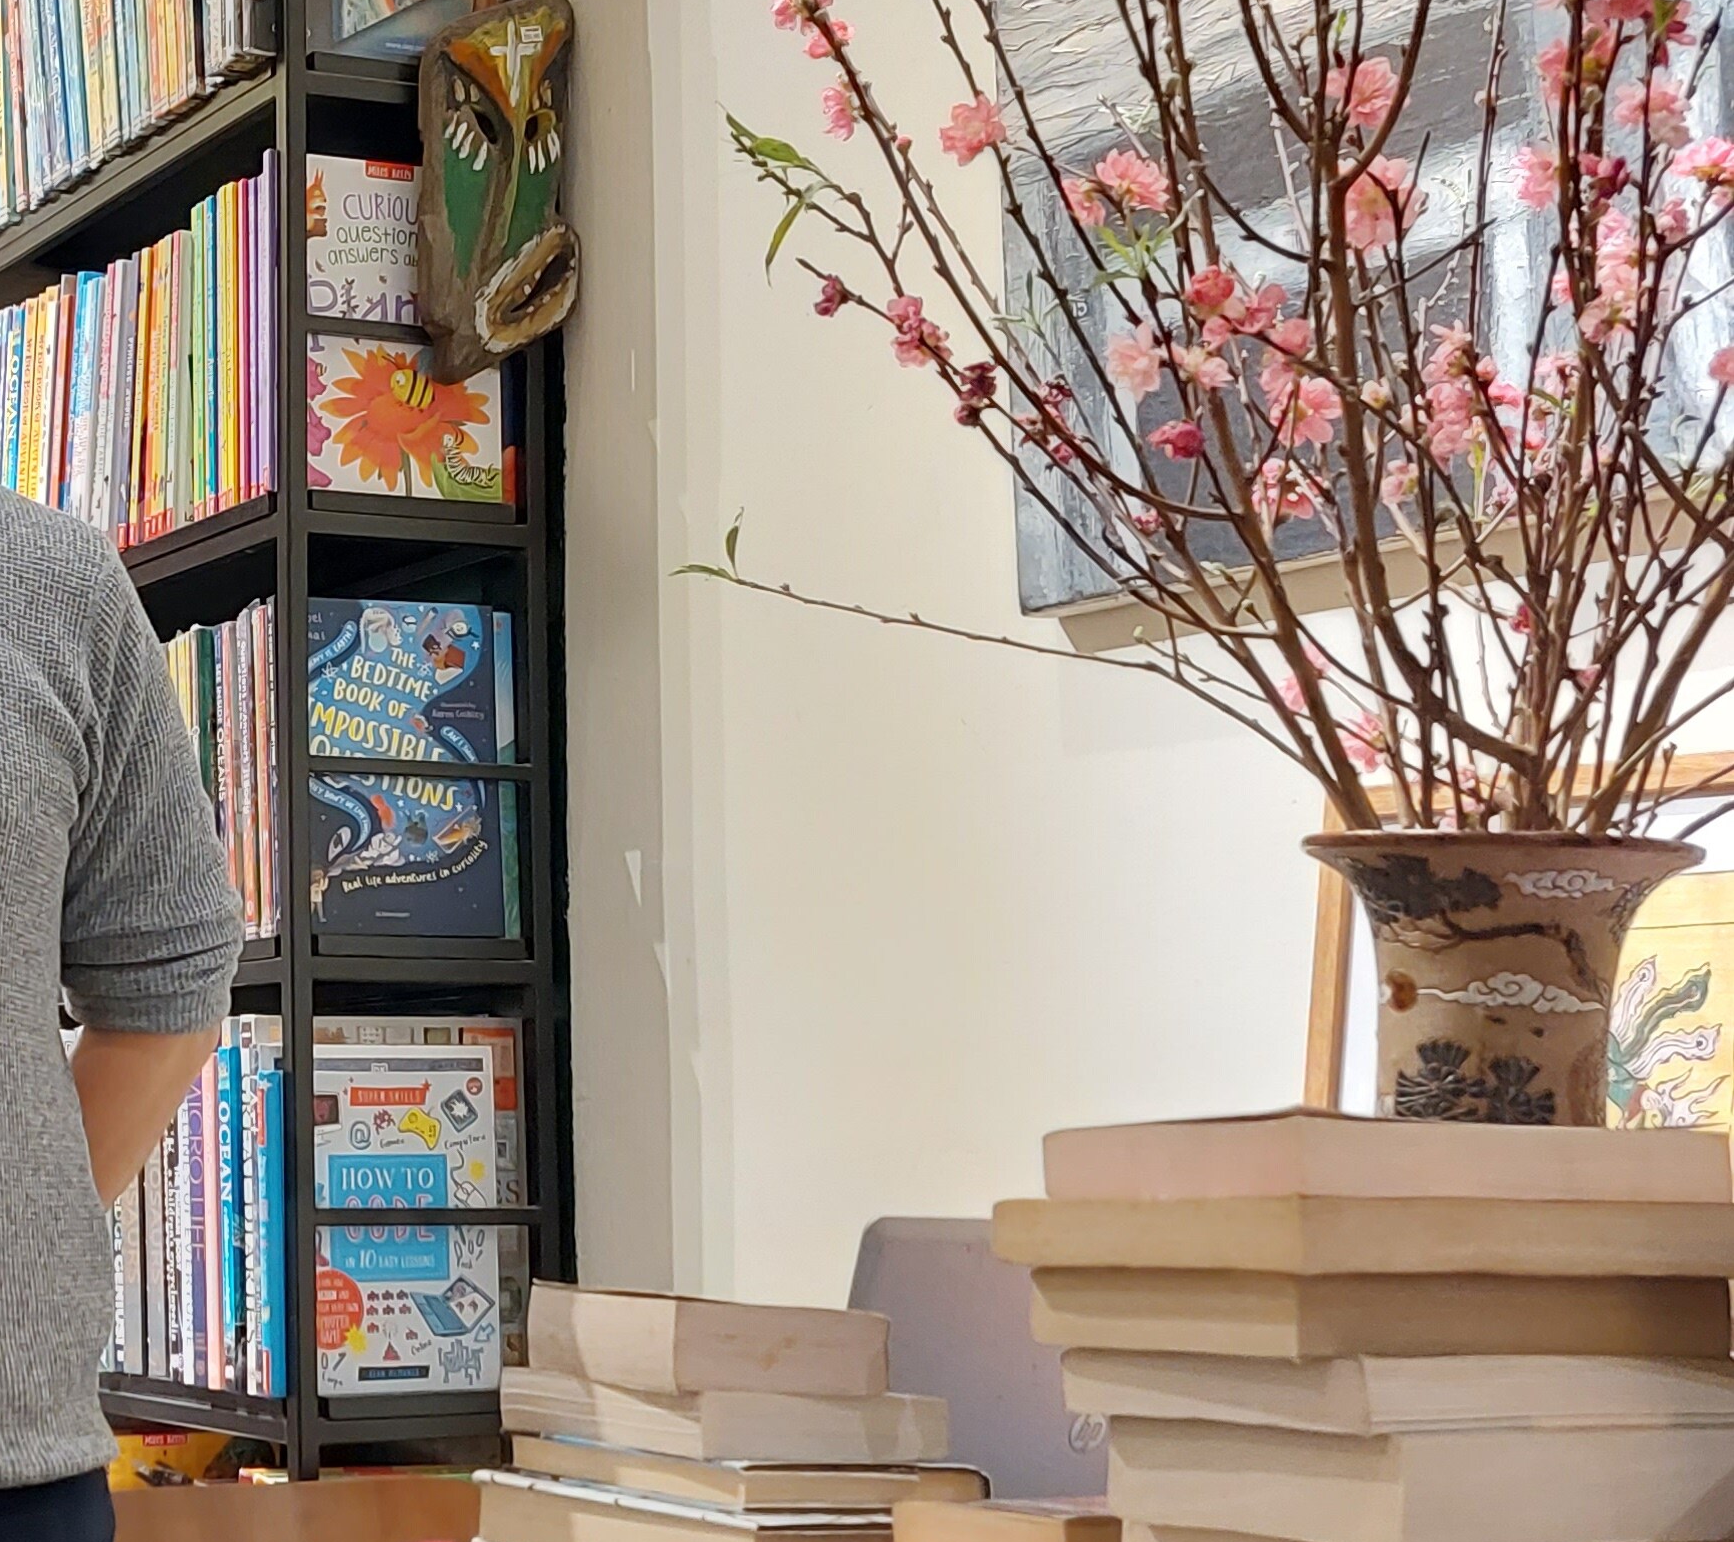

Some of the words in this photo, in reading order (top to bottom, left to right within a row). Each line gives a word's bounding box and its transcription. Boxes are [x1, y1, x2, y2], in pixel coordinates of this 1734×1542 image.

[327, 246, 400, 266] answers
[8, 354, 20, 440] OCEAN
[350, 655, 432, 703] BEDTIME
[391, 648, 416, 669] THE
[334, 678, 385, 712] BOOK
[388, 699, 412, 719] OF
[216, 727, 226, 802] OCEANS
[342, 879, 363, 893] Real
[365, 876, 382, 888] life
[385, 872, 437, 883] adventures
[439, 869, 450, 878] in
[451, 840, 488, 875] curiosity
[218, 1101, 232, 1204] OCEAN
[342, 1167, 396, 1190] HOW
[401, 1167, 434, 1189] TO
[190, 1195, 206, 1263] LIFE
[345, 1194, 436, 1243] CODE
[359, 1250, 377, 1267] 10
[379, 1256, 400, 1267] EASY
[1073, 1415, 1105, 1450] hp
